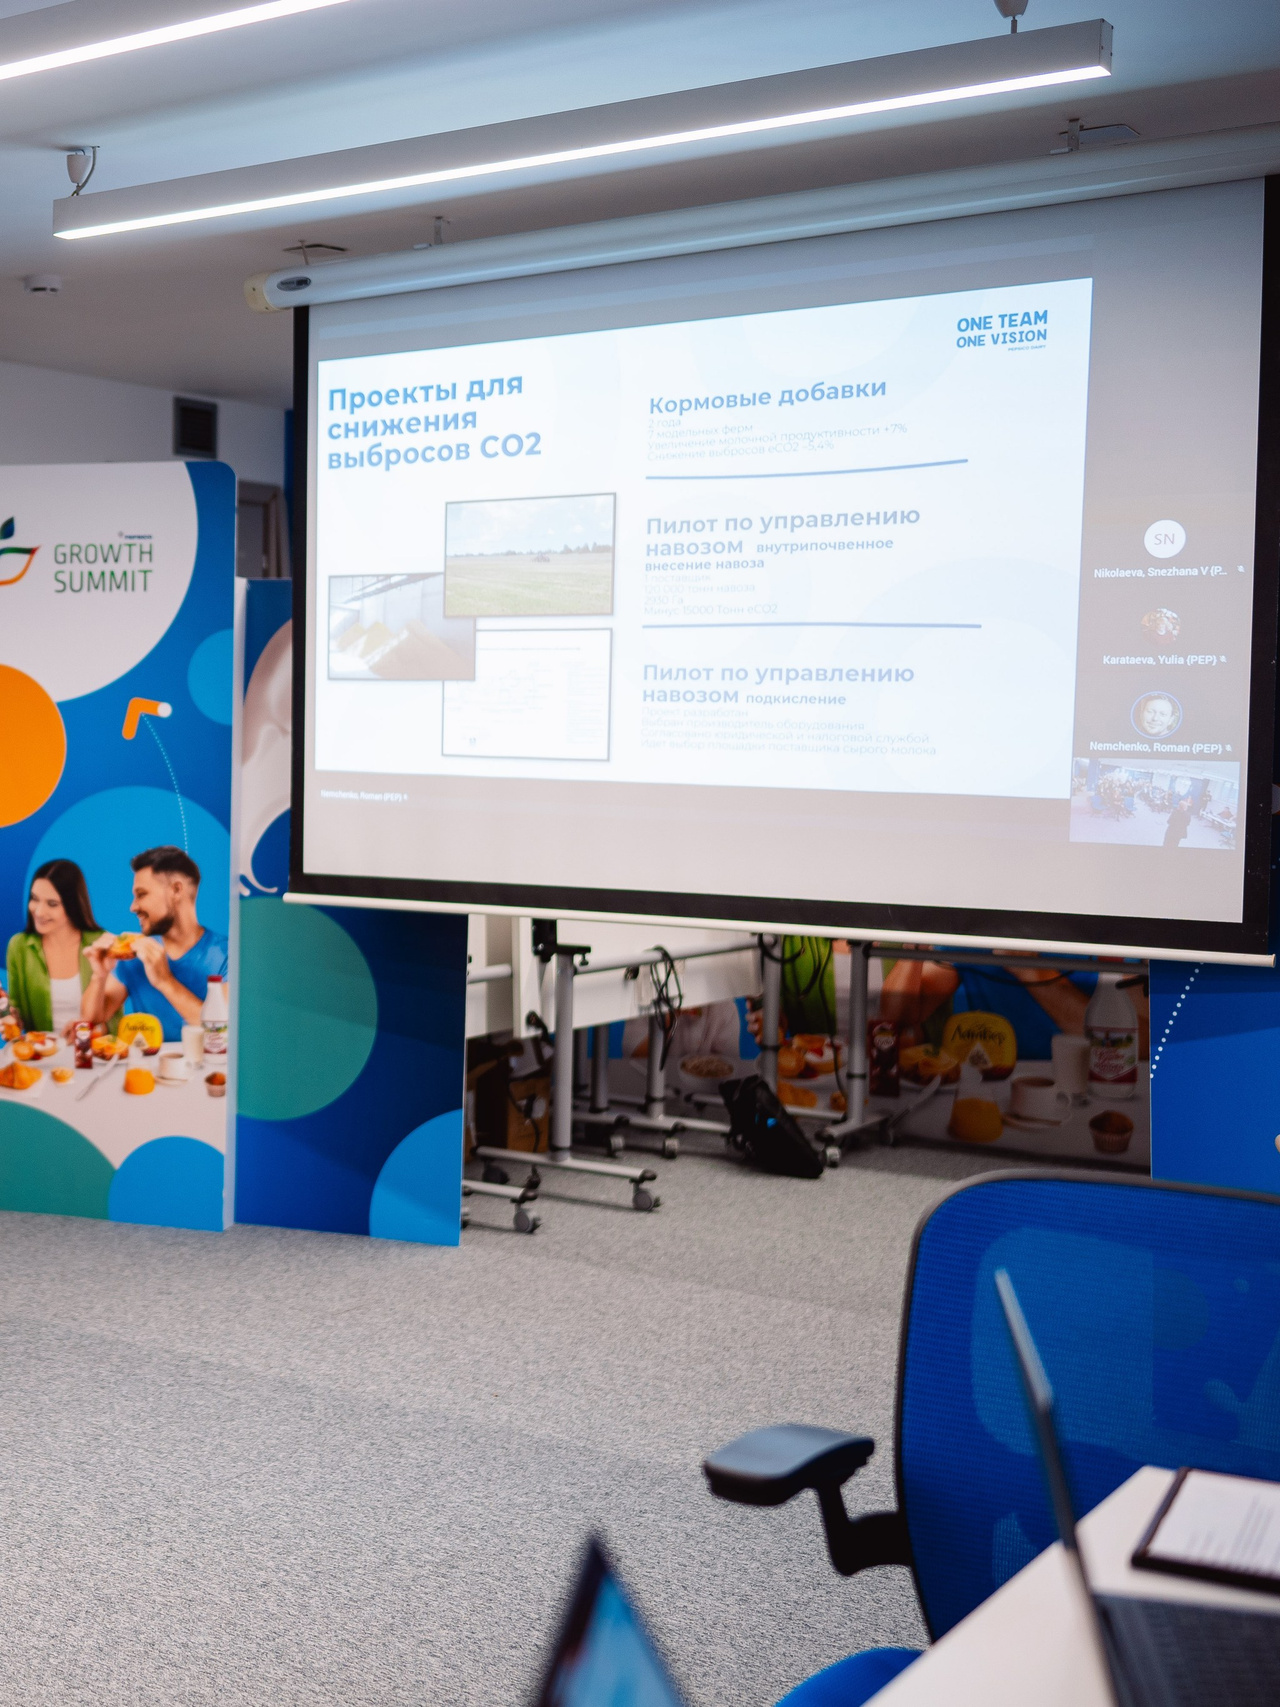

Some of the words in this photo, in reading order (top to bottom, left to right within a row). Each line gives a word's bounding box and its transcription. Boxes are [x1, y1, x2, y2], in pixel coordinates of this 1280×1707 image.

[957, 316, 993, 332] ONE
[998, 310, 1048, 328] TEAM
[956, 334, 986, 348] ONE
[991, 329, 1047, 345] VISION
[328, 382, 457, 414] Проекты
[466, 376, 523, 401] для
[650, 391, 771, 416] Кормовые
[778, 381, 886, 406] добавки
[328, 411, 477, 440] снижения
[657, 419, 681, 430] года
[657, 428, 718, 438] модельных
[722, 425, 753, 436] ферм
[648, 440, 716, 450] Увеличение
[719, 433, 777, 445] молочной
[780, 427, 880, 442] продуктивности
[328, 441, 470, 471] выбросов
[647, 450, 706, 461] Снижение
[709, 445, 765, 457] выбросов
[647, 516, 718, 535] Пилот
[724, 514, 753, 532] по
[759, 508, 921, 534] управлению
[646, 540, 744, 557] навозом
[756, 538, 894, 555] внутрипочвенное
[1154, 533, 1175, 546] SN
[54, 543, 153, 564] GROWTH
[645, 560, 712, 572] внесение
[716, 558, 765, 570] навоза
[1094, 568, 1145, 578] Nikolaeva,
[1148, 566, 1198, 577] Snezhana
[1200, 566, 1209, 575] V
[54, 569, 153, 593] SUMMIT
[717, 584, 756, 593] навоза
[1103, 655, 1156, 665] Karataeva,
[1158, 655, 1184, 664] Yulia
[643, 664, 714, 681] Пилот
[720, 665, 748, 682] по
[755, 665, 915, 686] управлению
[642, 687, 740, 704] навозом
[746, 692, 846, 705] подкисление
[776, 718, 865, 731] оборудования
[807, 732, 873, 742] налоговой
[876, 732, 930, 744] службой
[1089, 741, 1151, 752] Nemchenko,
[1153, 742, 1190, 752] Roman
[891, 746, 937, 756] молока
